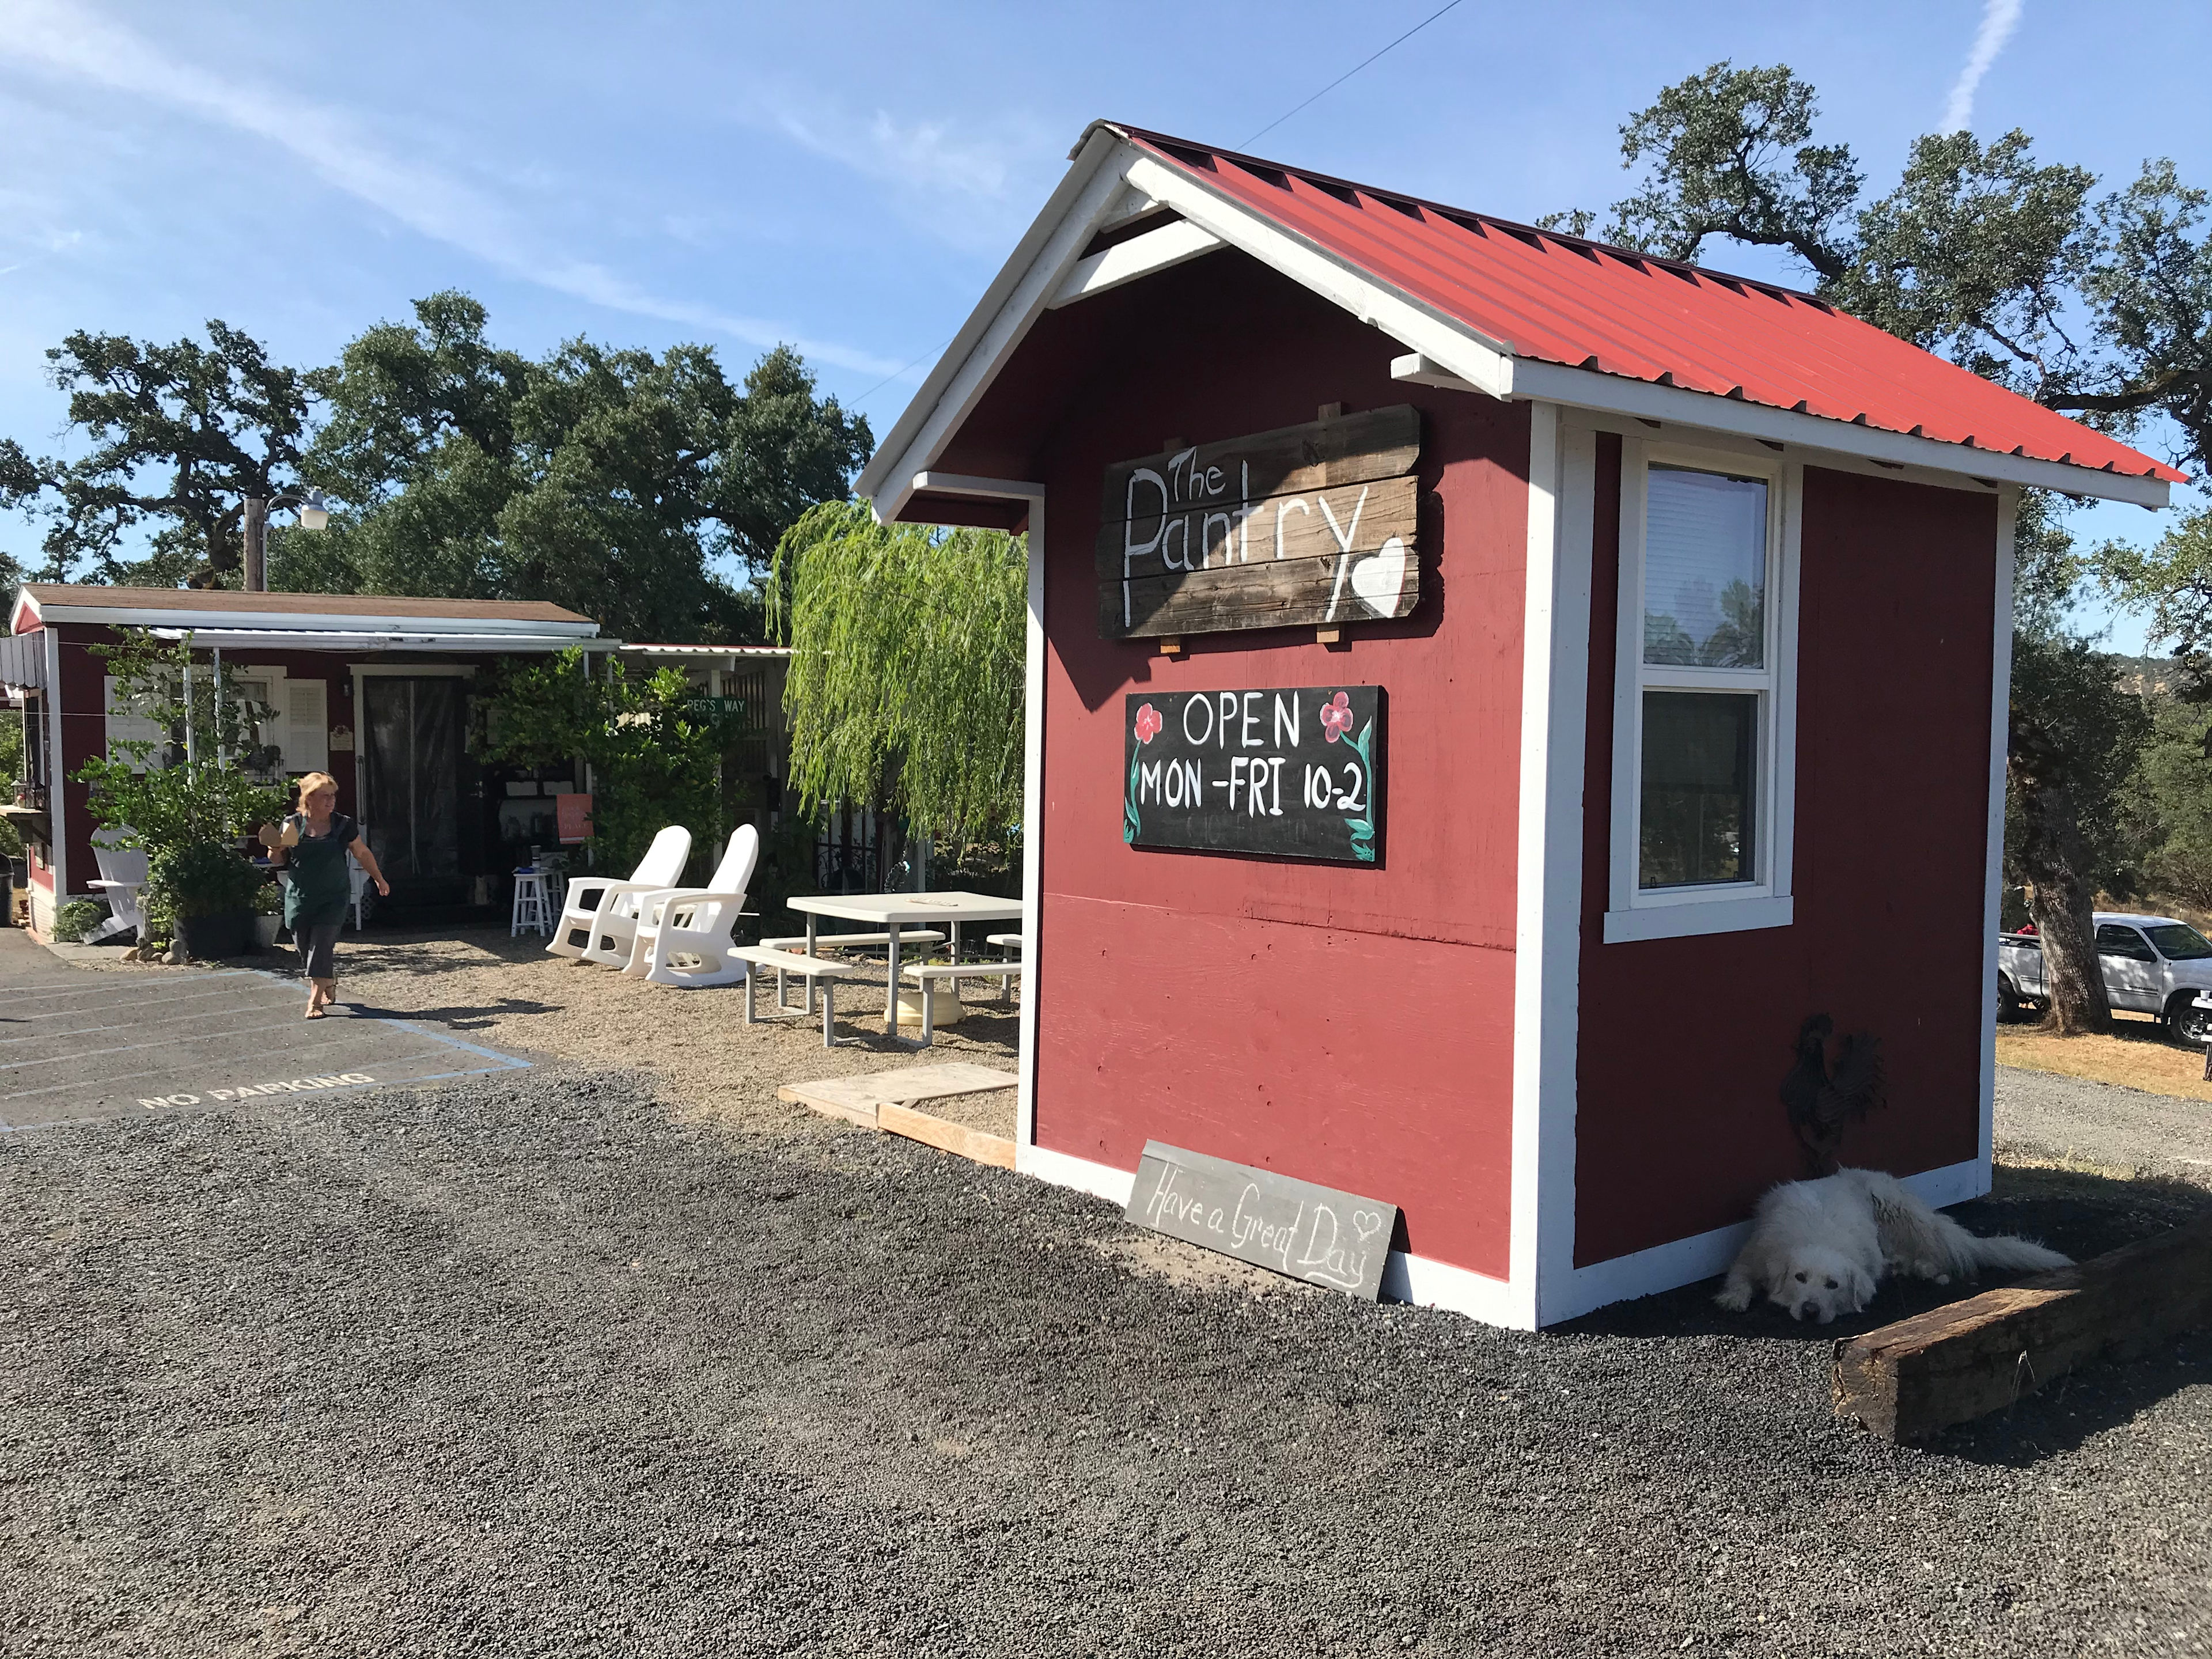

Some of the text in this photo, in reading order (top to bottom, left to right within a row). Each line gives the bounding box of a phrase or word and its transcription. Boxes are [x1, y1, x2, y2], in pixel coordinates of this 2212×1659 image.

[1168, 446, 1226, 501] The
[1123, 460, 1368, 627] Pantry
[724, 700, 744, 711] WAY
[1183, 691, 1299, 749] OPEN
[1304, 762, 1366, 812] 10-2
[136, 1073, 375, 1109] NO PARKING
[1146, 1162, 1366, 1288] Have a Great Day
